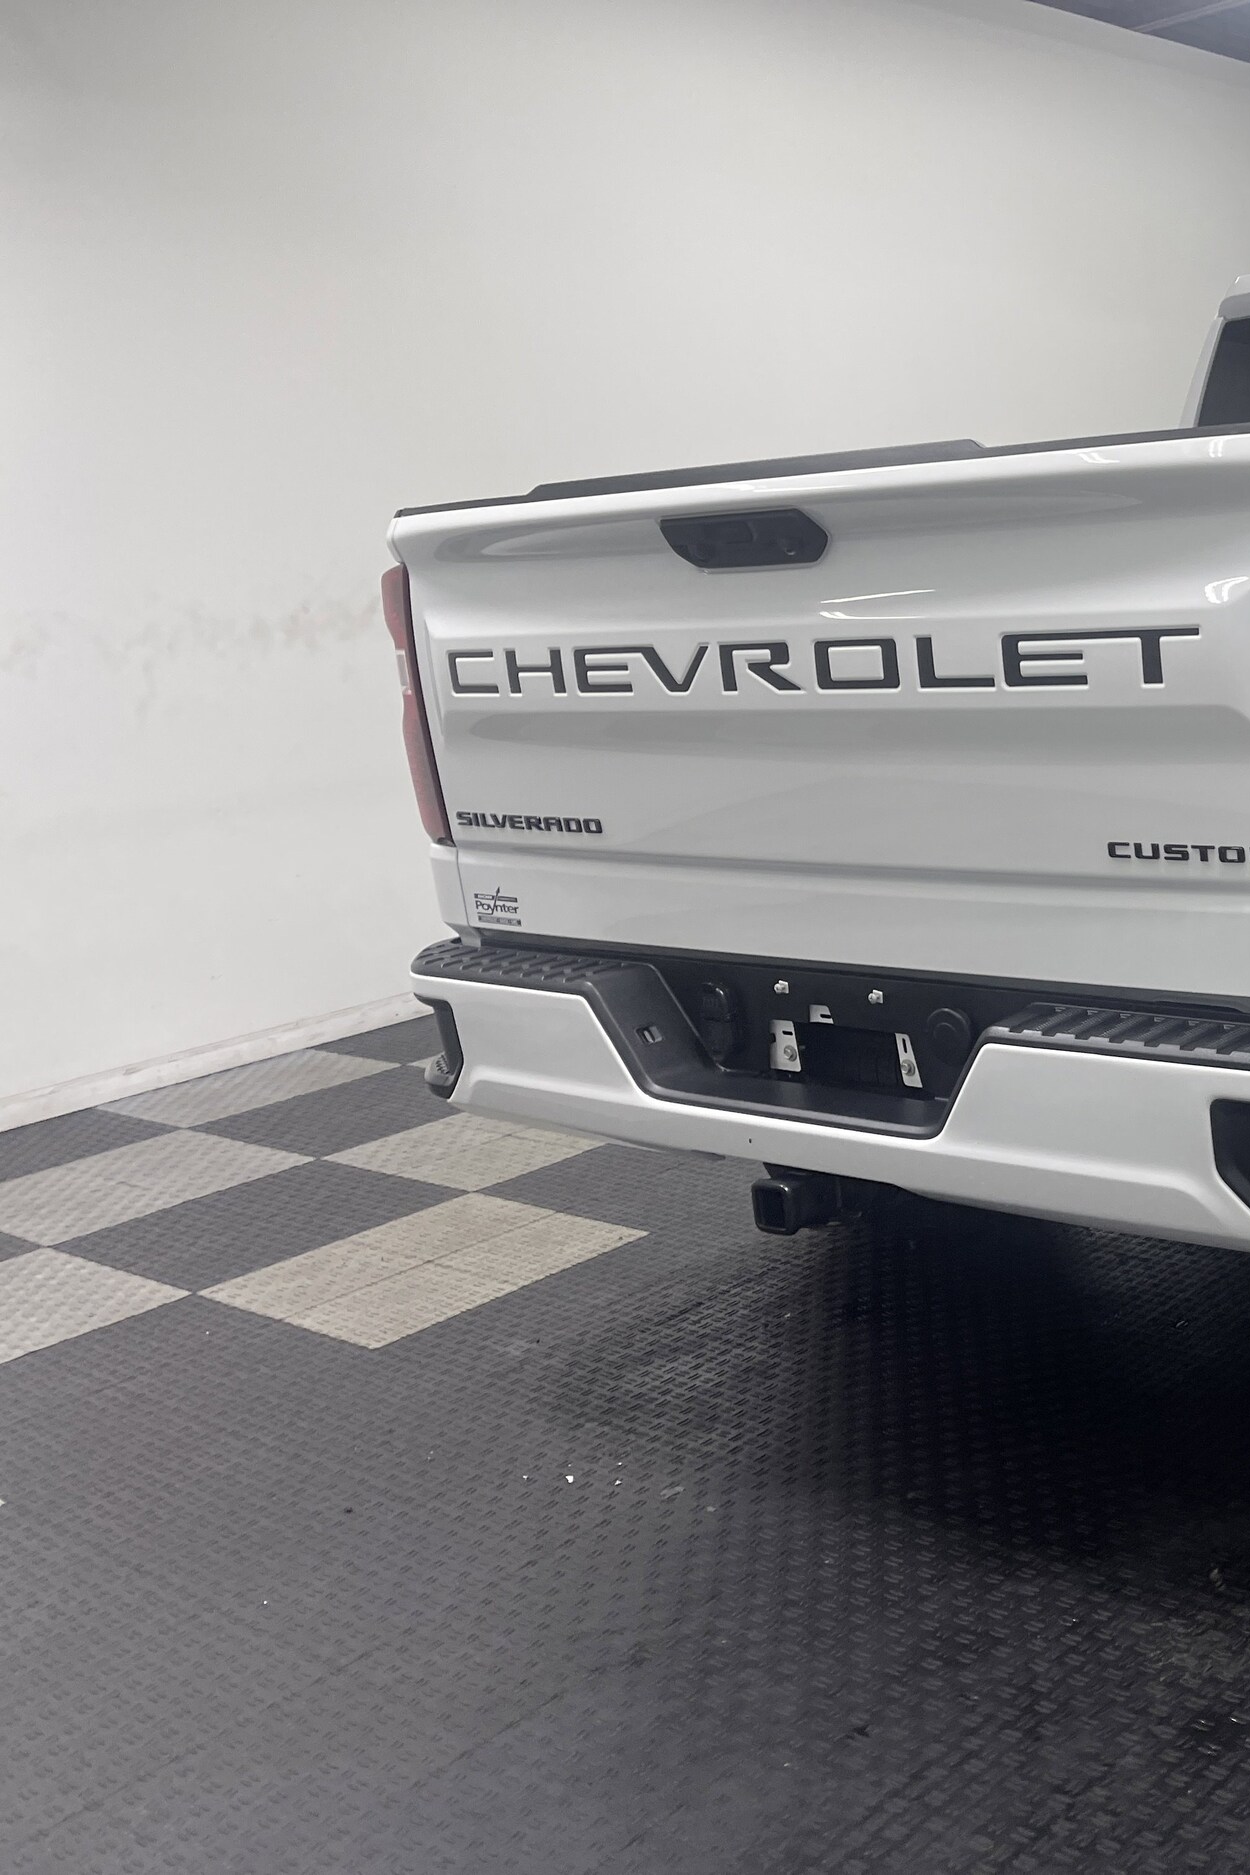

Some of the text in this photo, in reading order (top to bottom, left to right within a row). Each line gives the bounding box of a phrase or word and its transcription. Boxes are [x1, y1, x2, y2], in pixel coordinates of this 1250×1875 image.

[446, 628, 1200, 695] CHEVROLET
[456, 811, 603, 834] SILVERADO
[475, 899, 520, 915] Poynter
